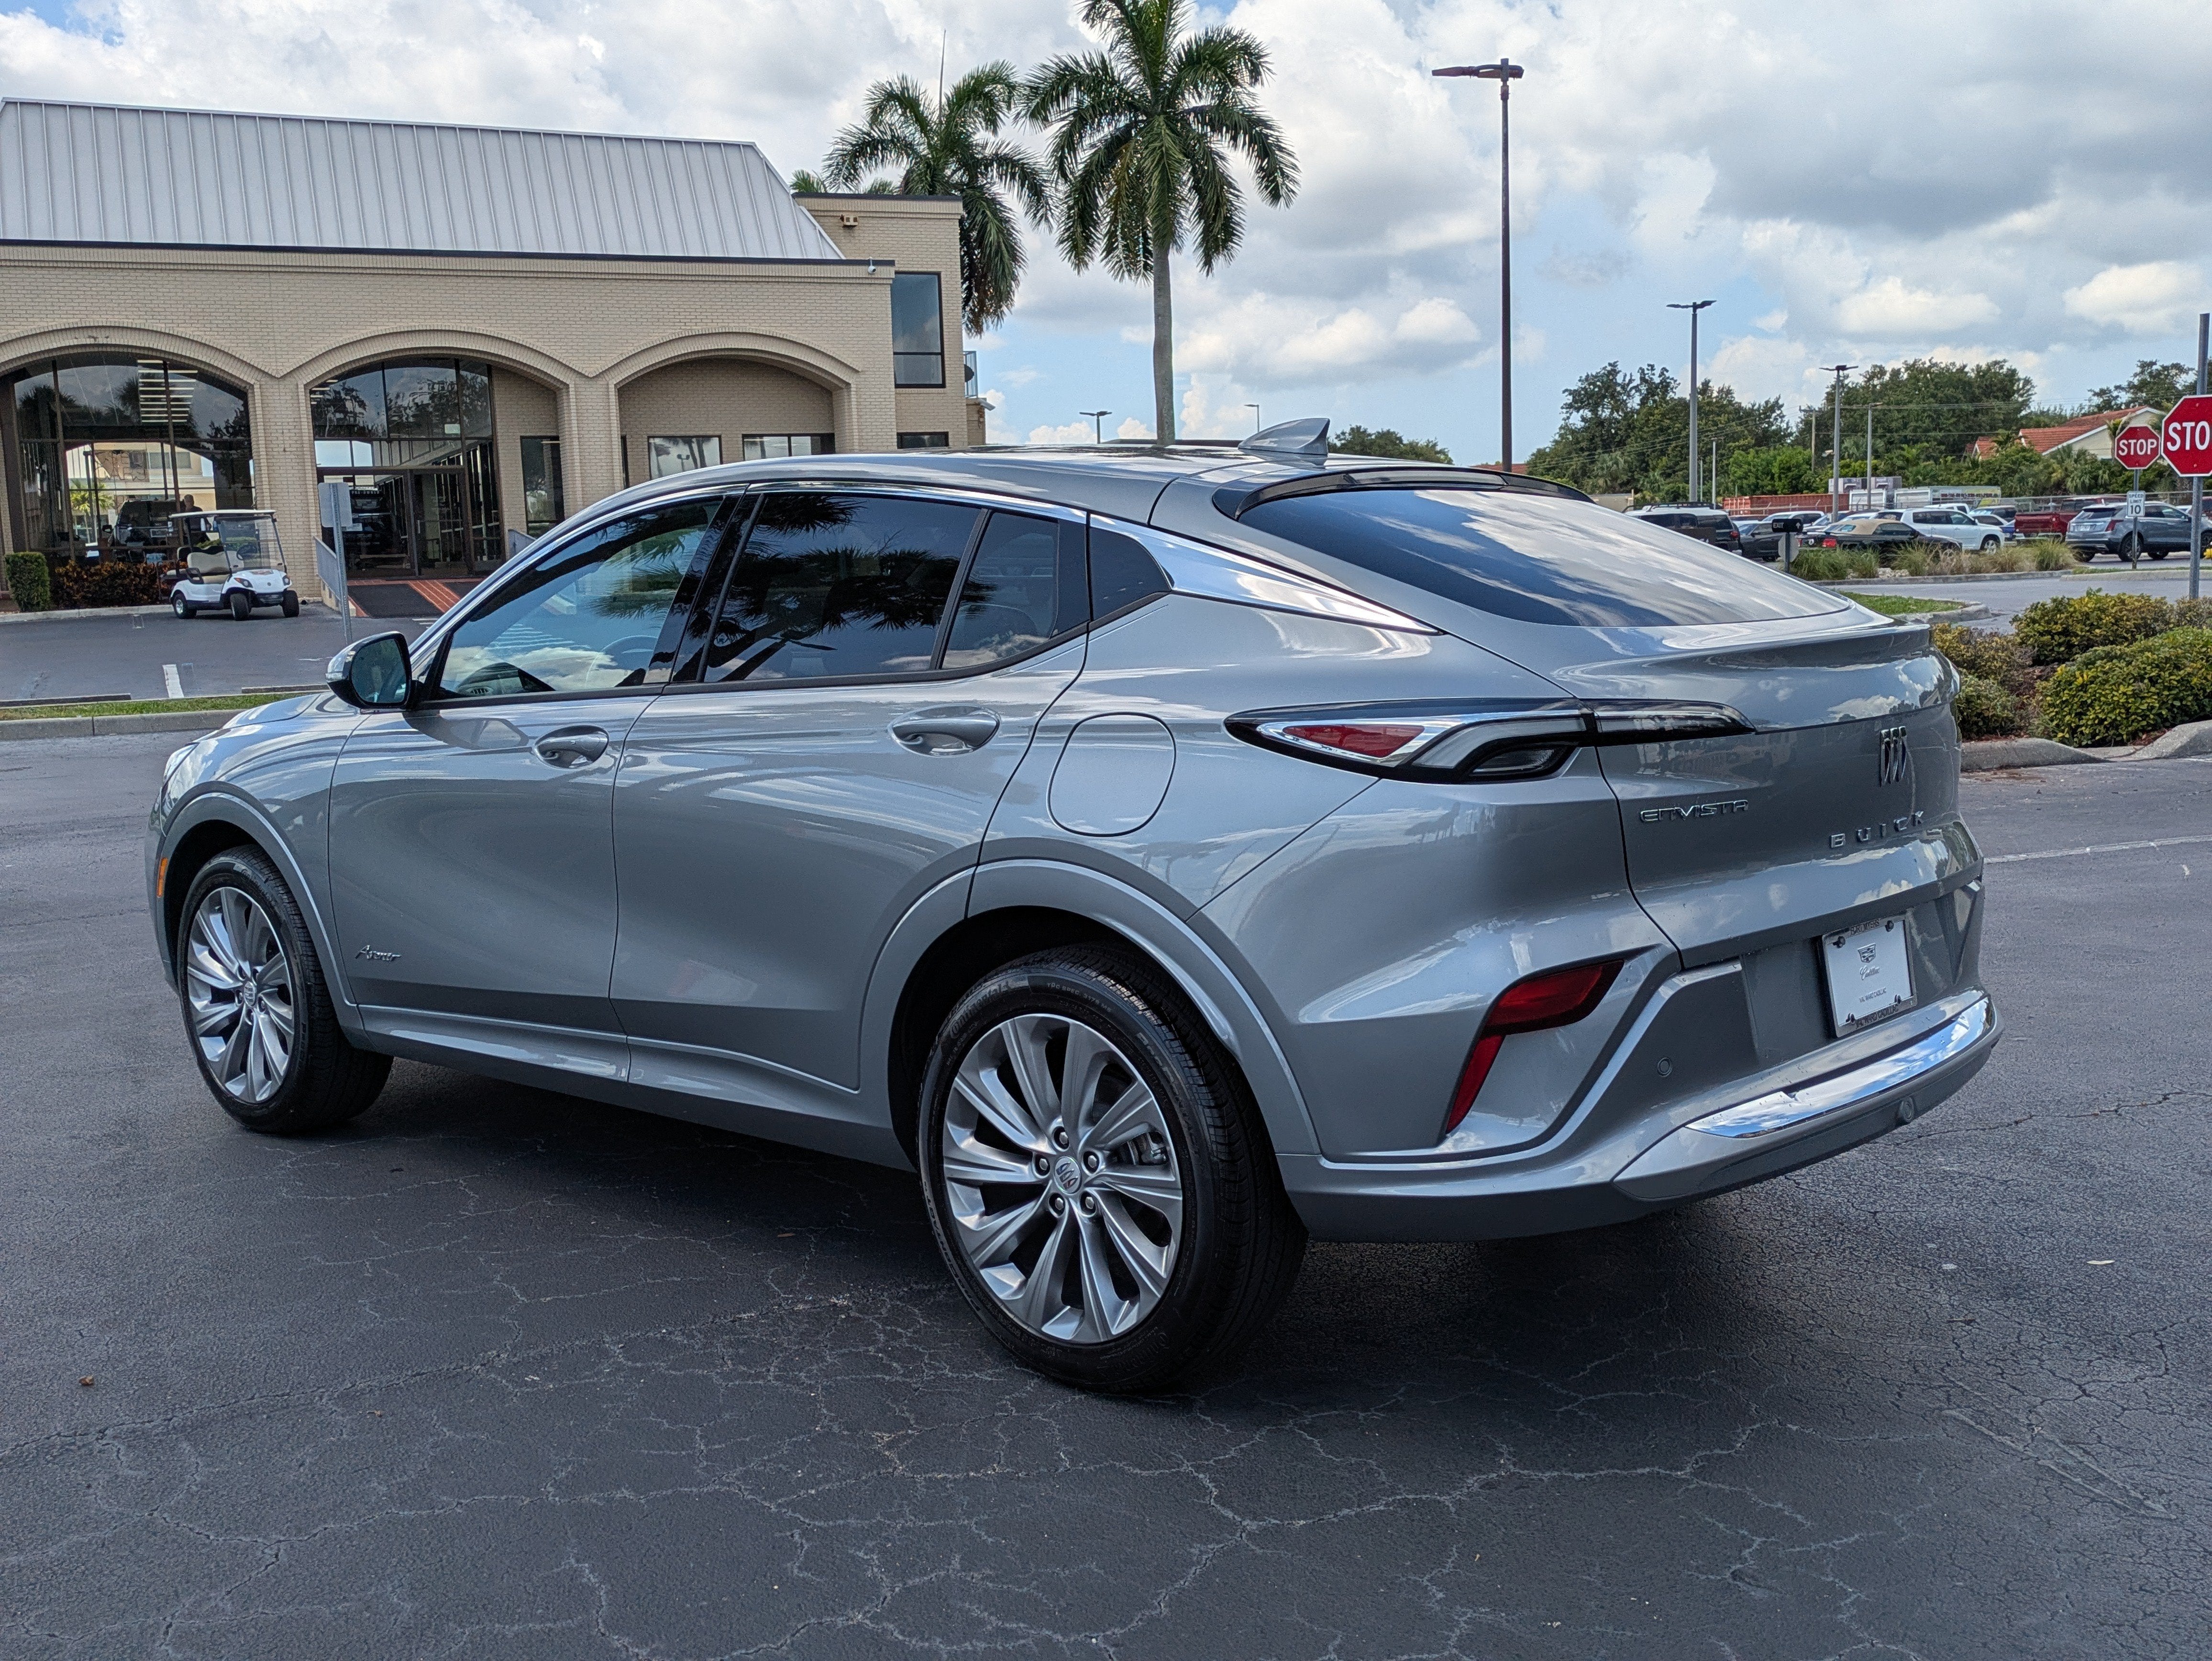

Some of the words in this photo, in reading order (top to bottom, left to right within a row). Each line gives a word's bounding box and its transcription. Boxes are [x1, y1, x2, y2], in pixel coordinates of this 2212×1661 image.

[2118, 439, 2157, 455] STOP
[2167, 421, 2210, 451] STO
[2131, 505, 2141, 514] 10
[1640, 799, 1749, 822] ENVISTA
[1830, 811, 1924, 848] BUICK
